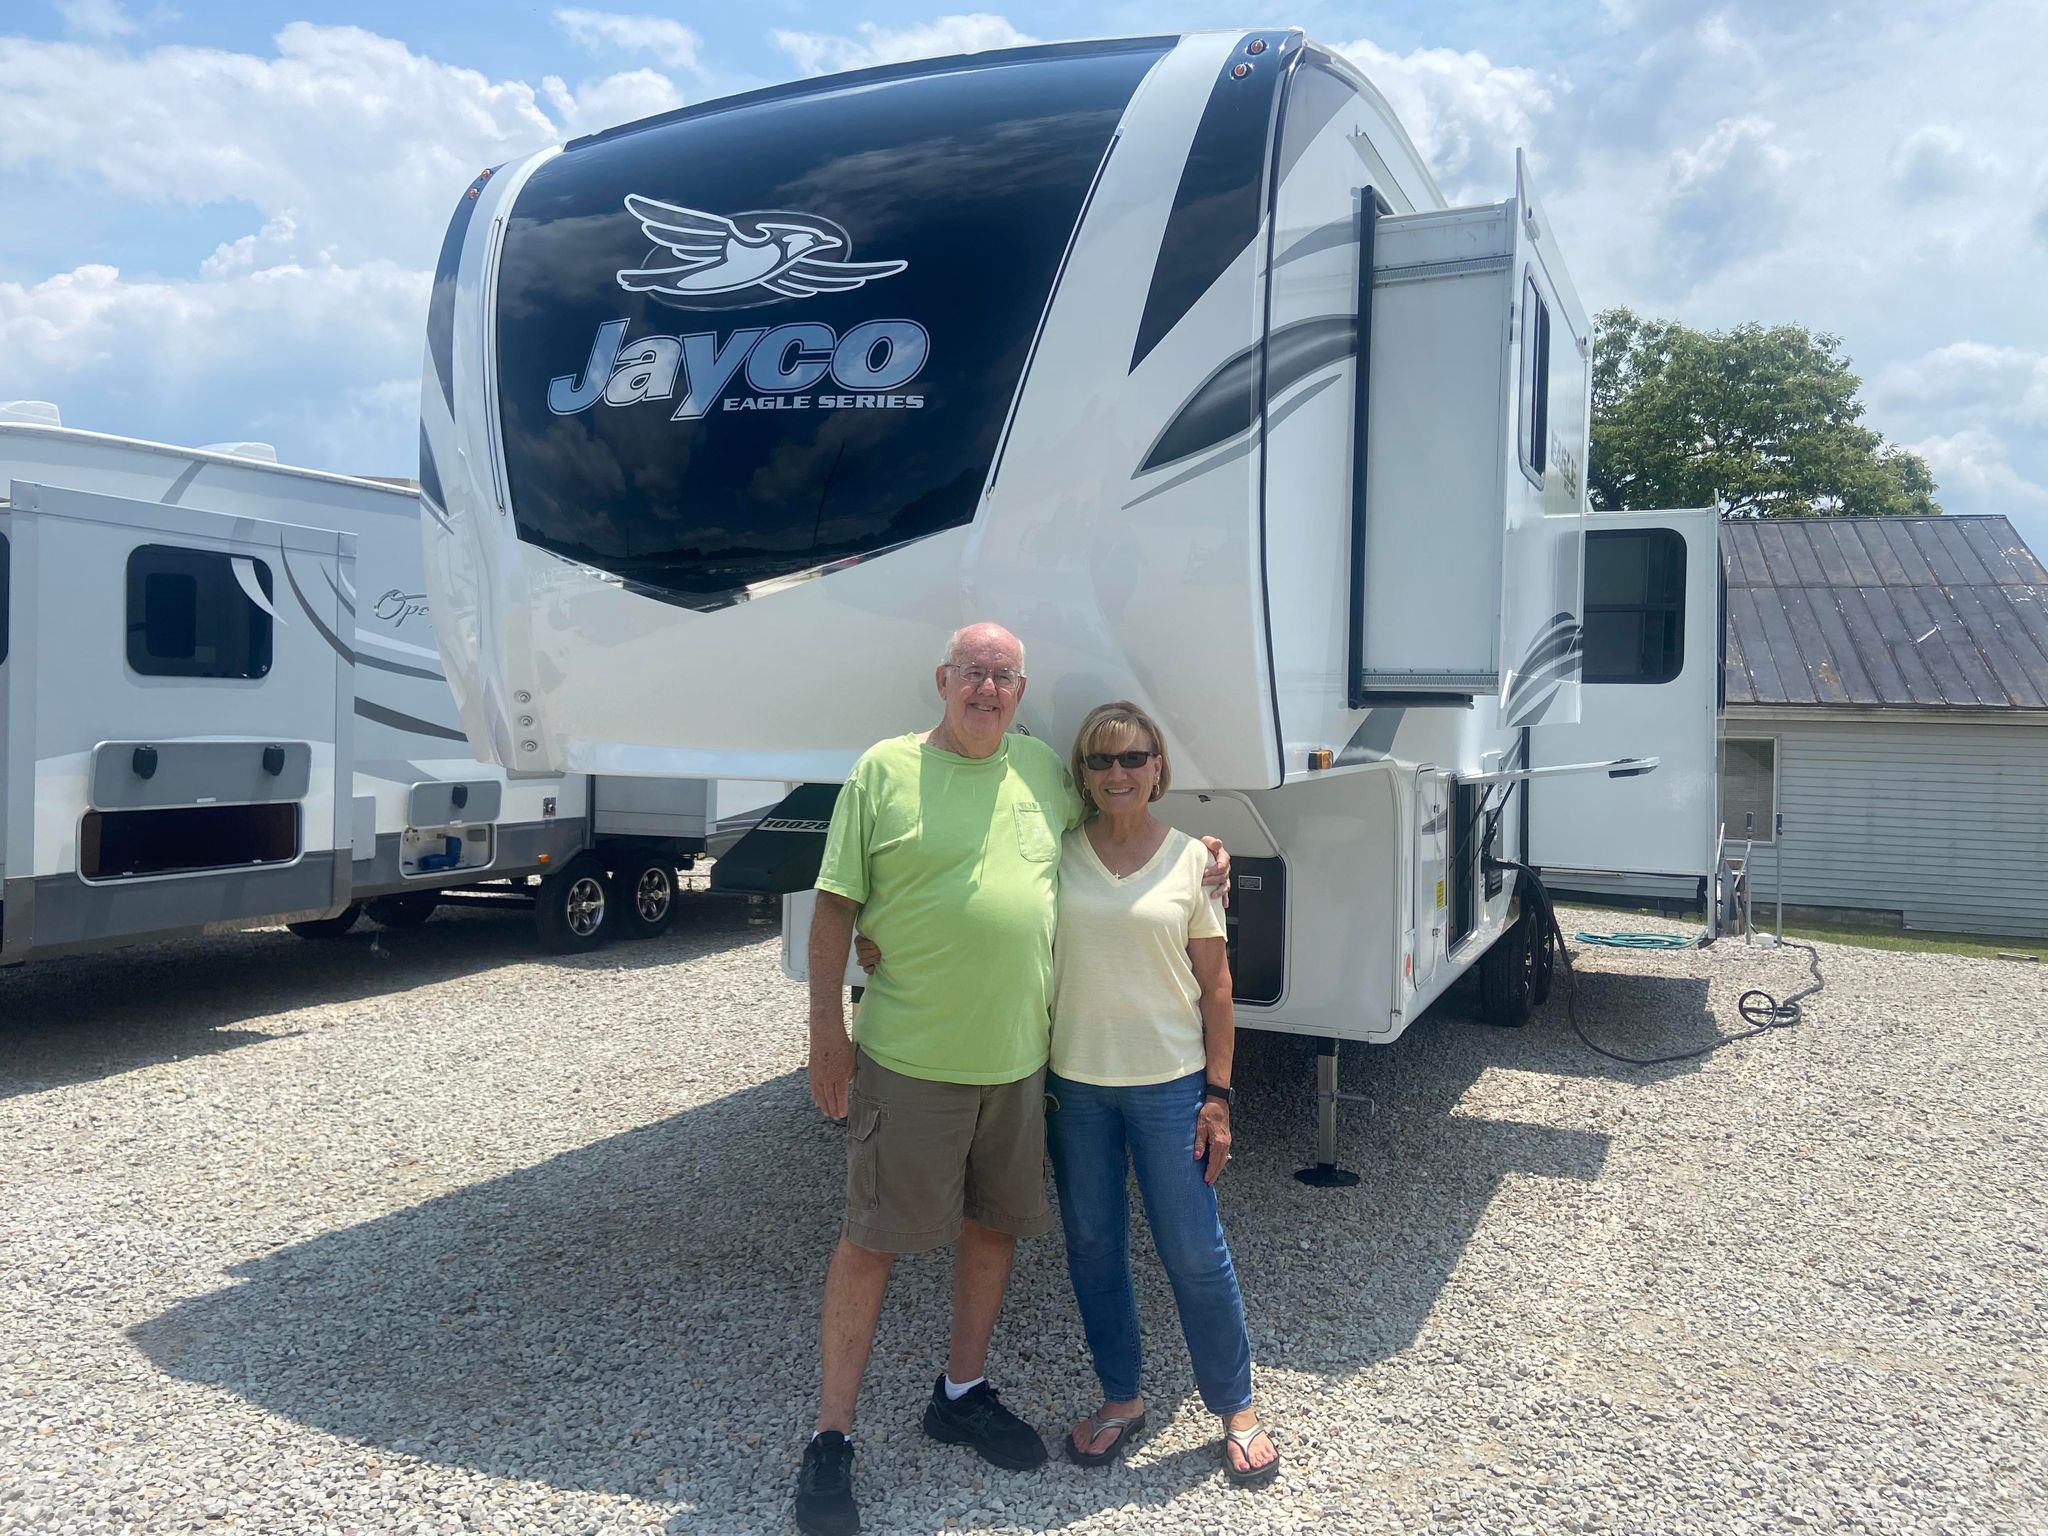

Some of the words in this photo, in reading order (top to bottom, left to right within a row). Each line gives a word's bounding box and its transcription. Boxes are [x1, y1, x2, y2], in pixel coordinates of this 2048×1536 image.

[547, 317, 930, 421] Jayco
[723, 395, 811, 411] EAGLE
[818, 394, 925, 410] SERIES
[373, 588, 430, 628] Ope
